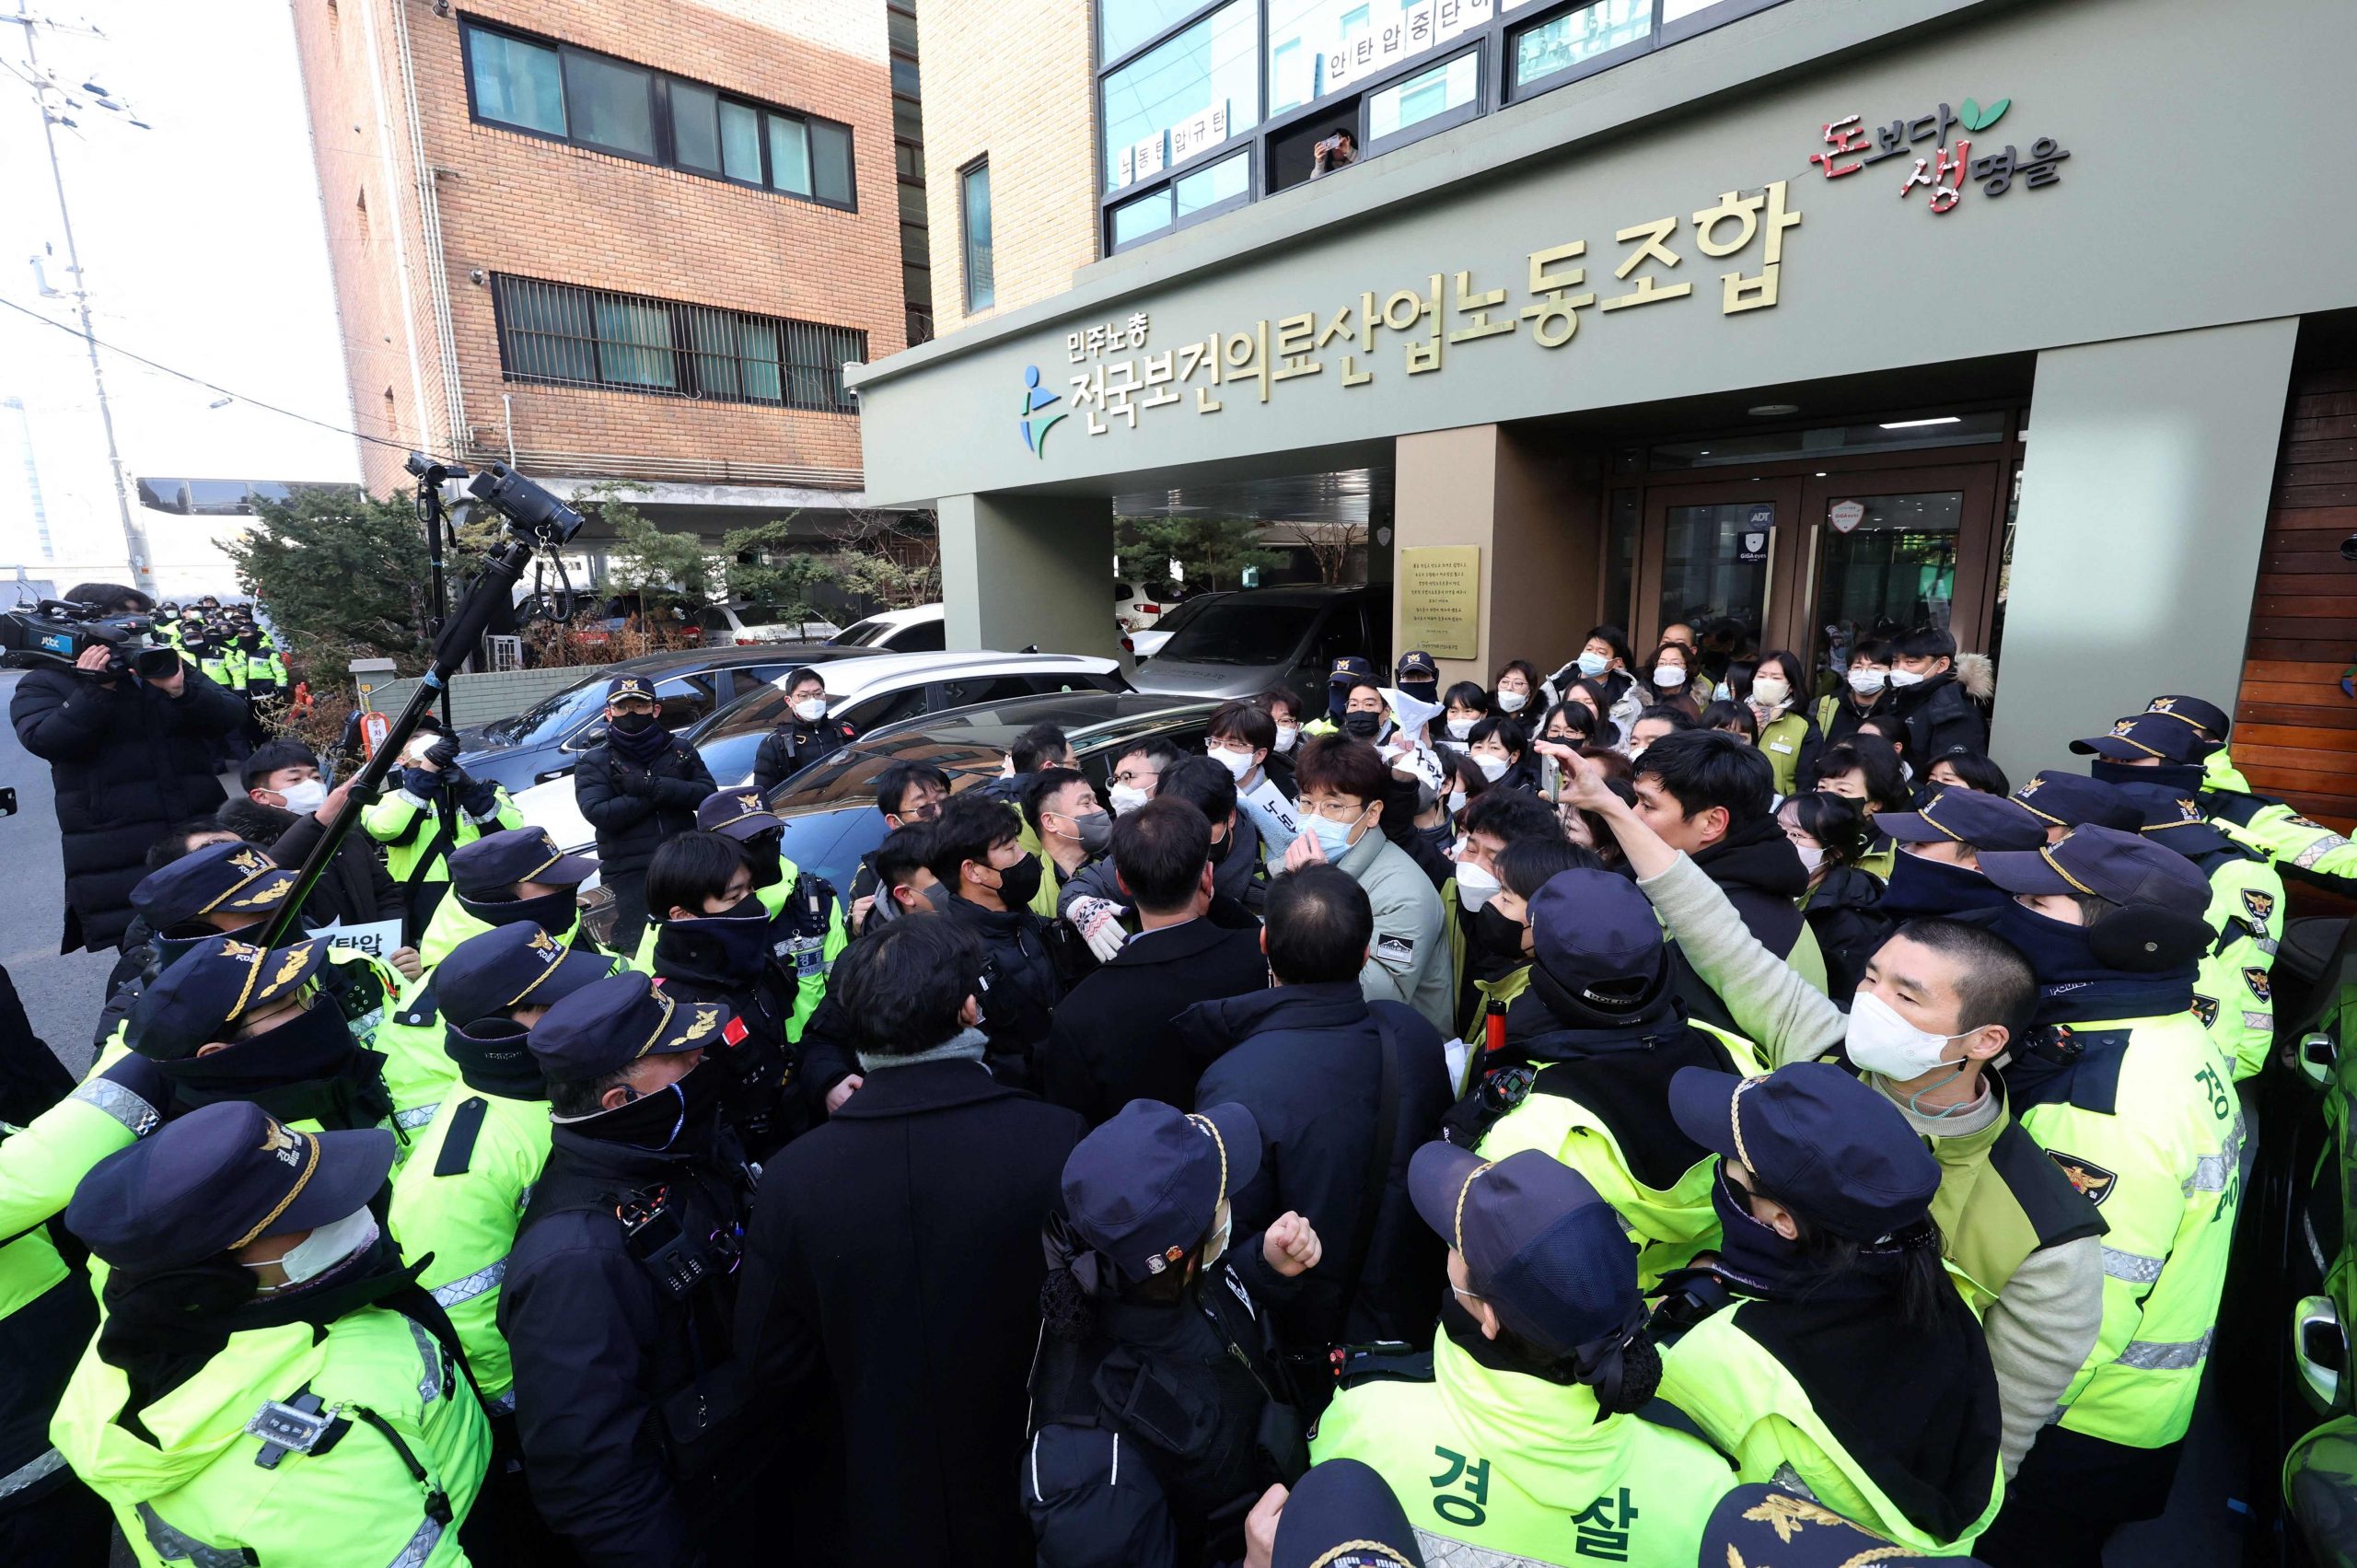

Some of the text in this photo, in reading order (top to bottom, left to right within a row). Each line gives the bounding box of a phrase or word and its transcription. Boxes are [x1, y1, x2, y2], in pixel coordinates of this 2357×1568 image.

[1809, 102, 1958, 180] 돈보다
[1899, 135, 2071, 215] 생명을
[1066, 311, 1150, 364] 민주노총
[1069, 179, 1803, 436] 전국보건의료산업노동조합
[1750, 512, 1771, 522] ADT
